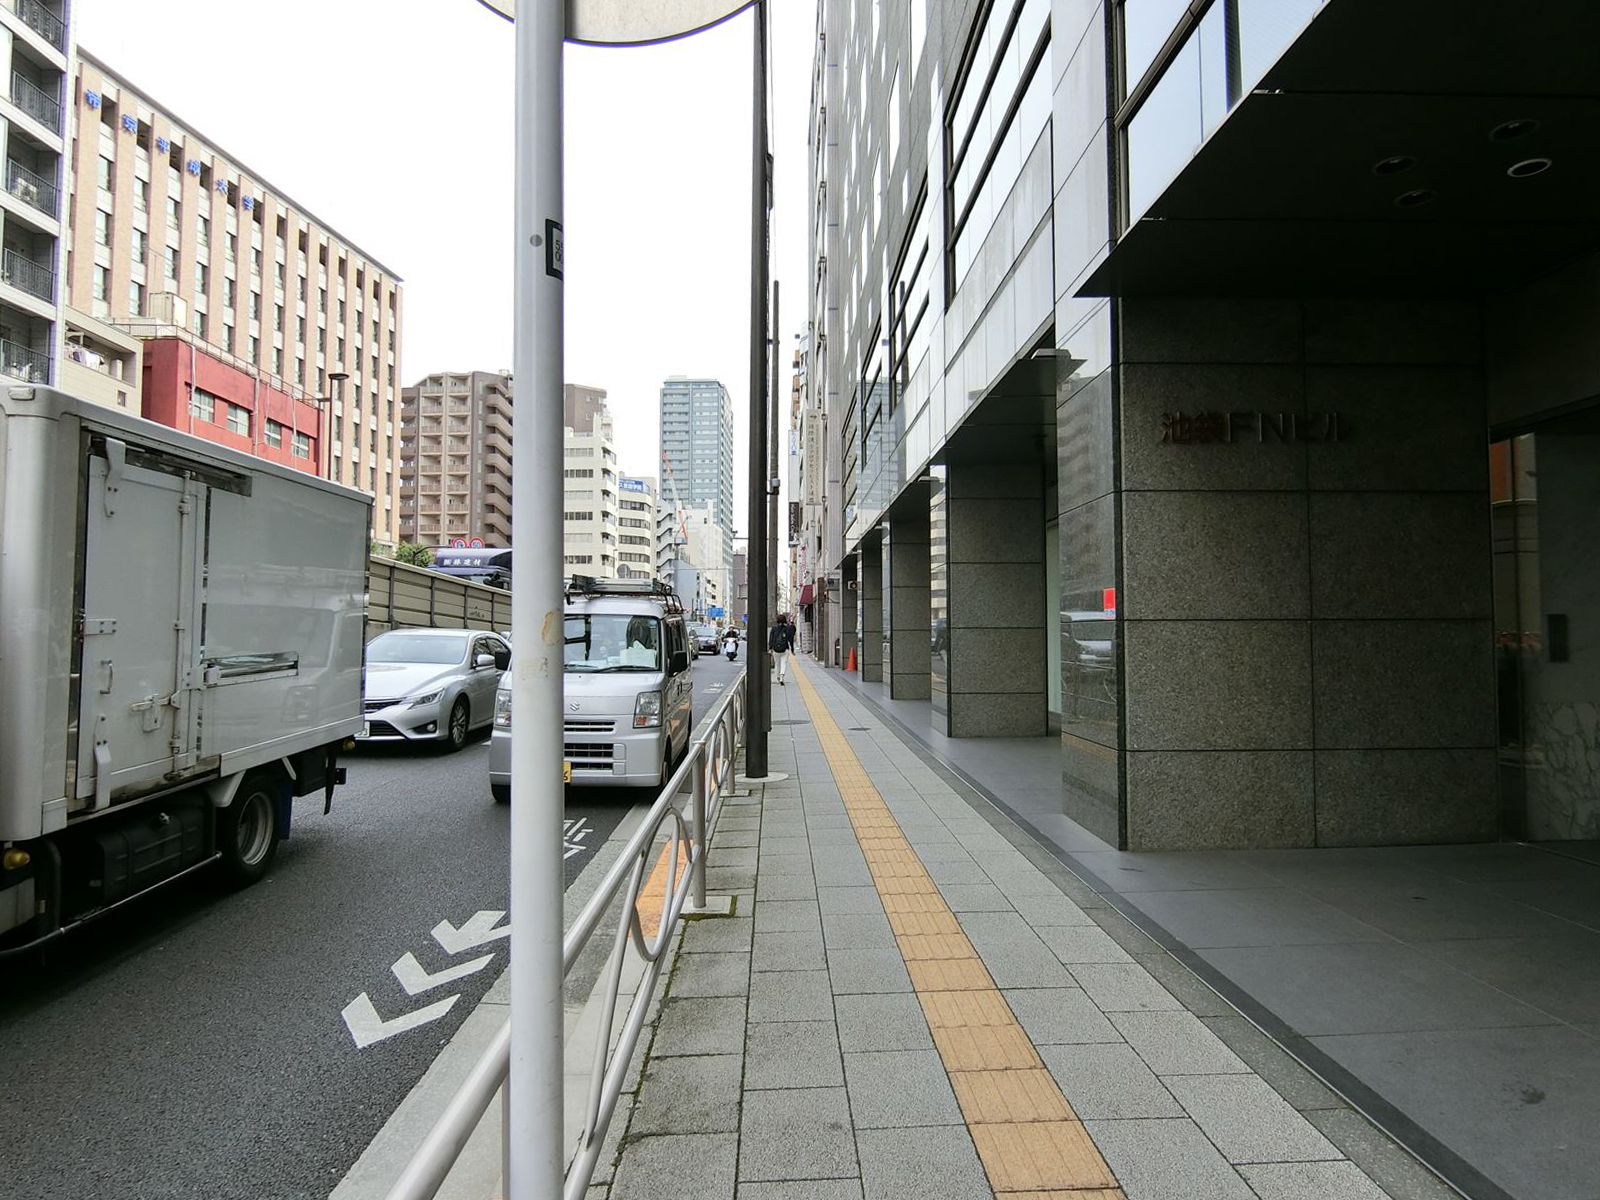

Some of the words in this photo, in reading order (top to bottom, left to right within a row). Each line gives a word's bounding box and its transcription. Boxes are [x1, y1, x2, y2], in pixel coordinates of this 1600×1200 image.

[85, 89, 254, 210] 帝京平成大学
